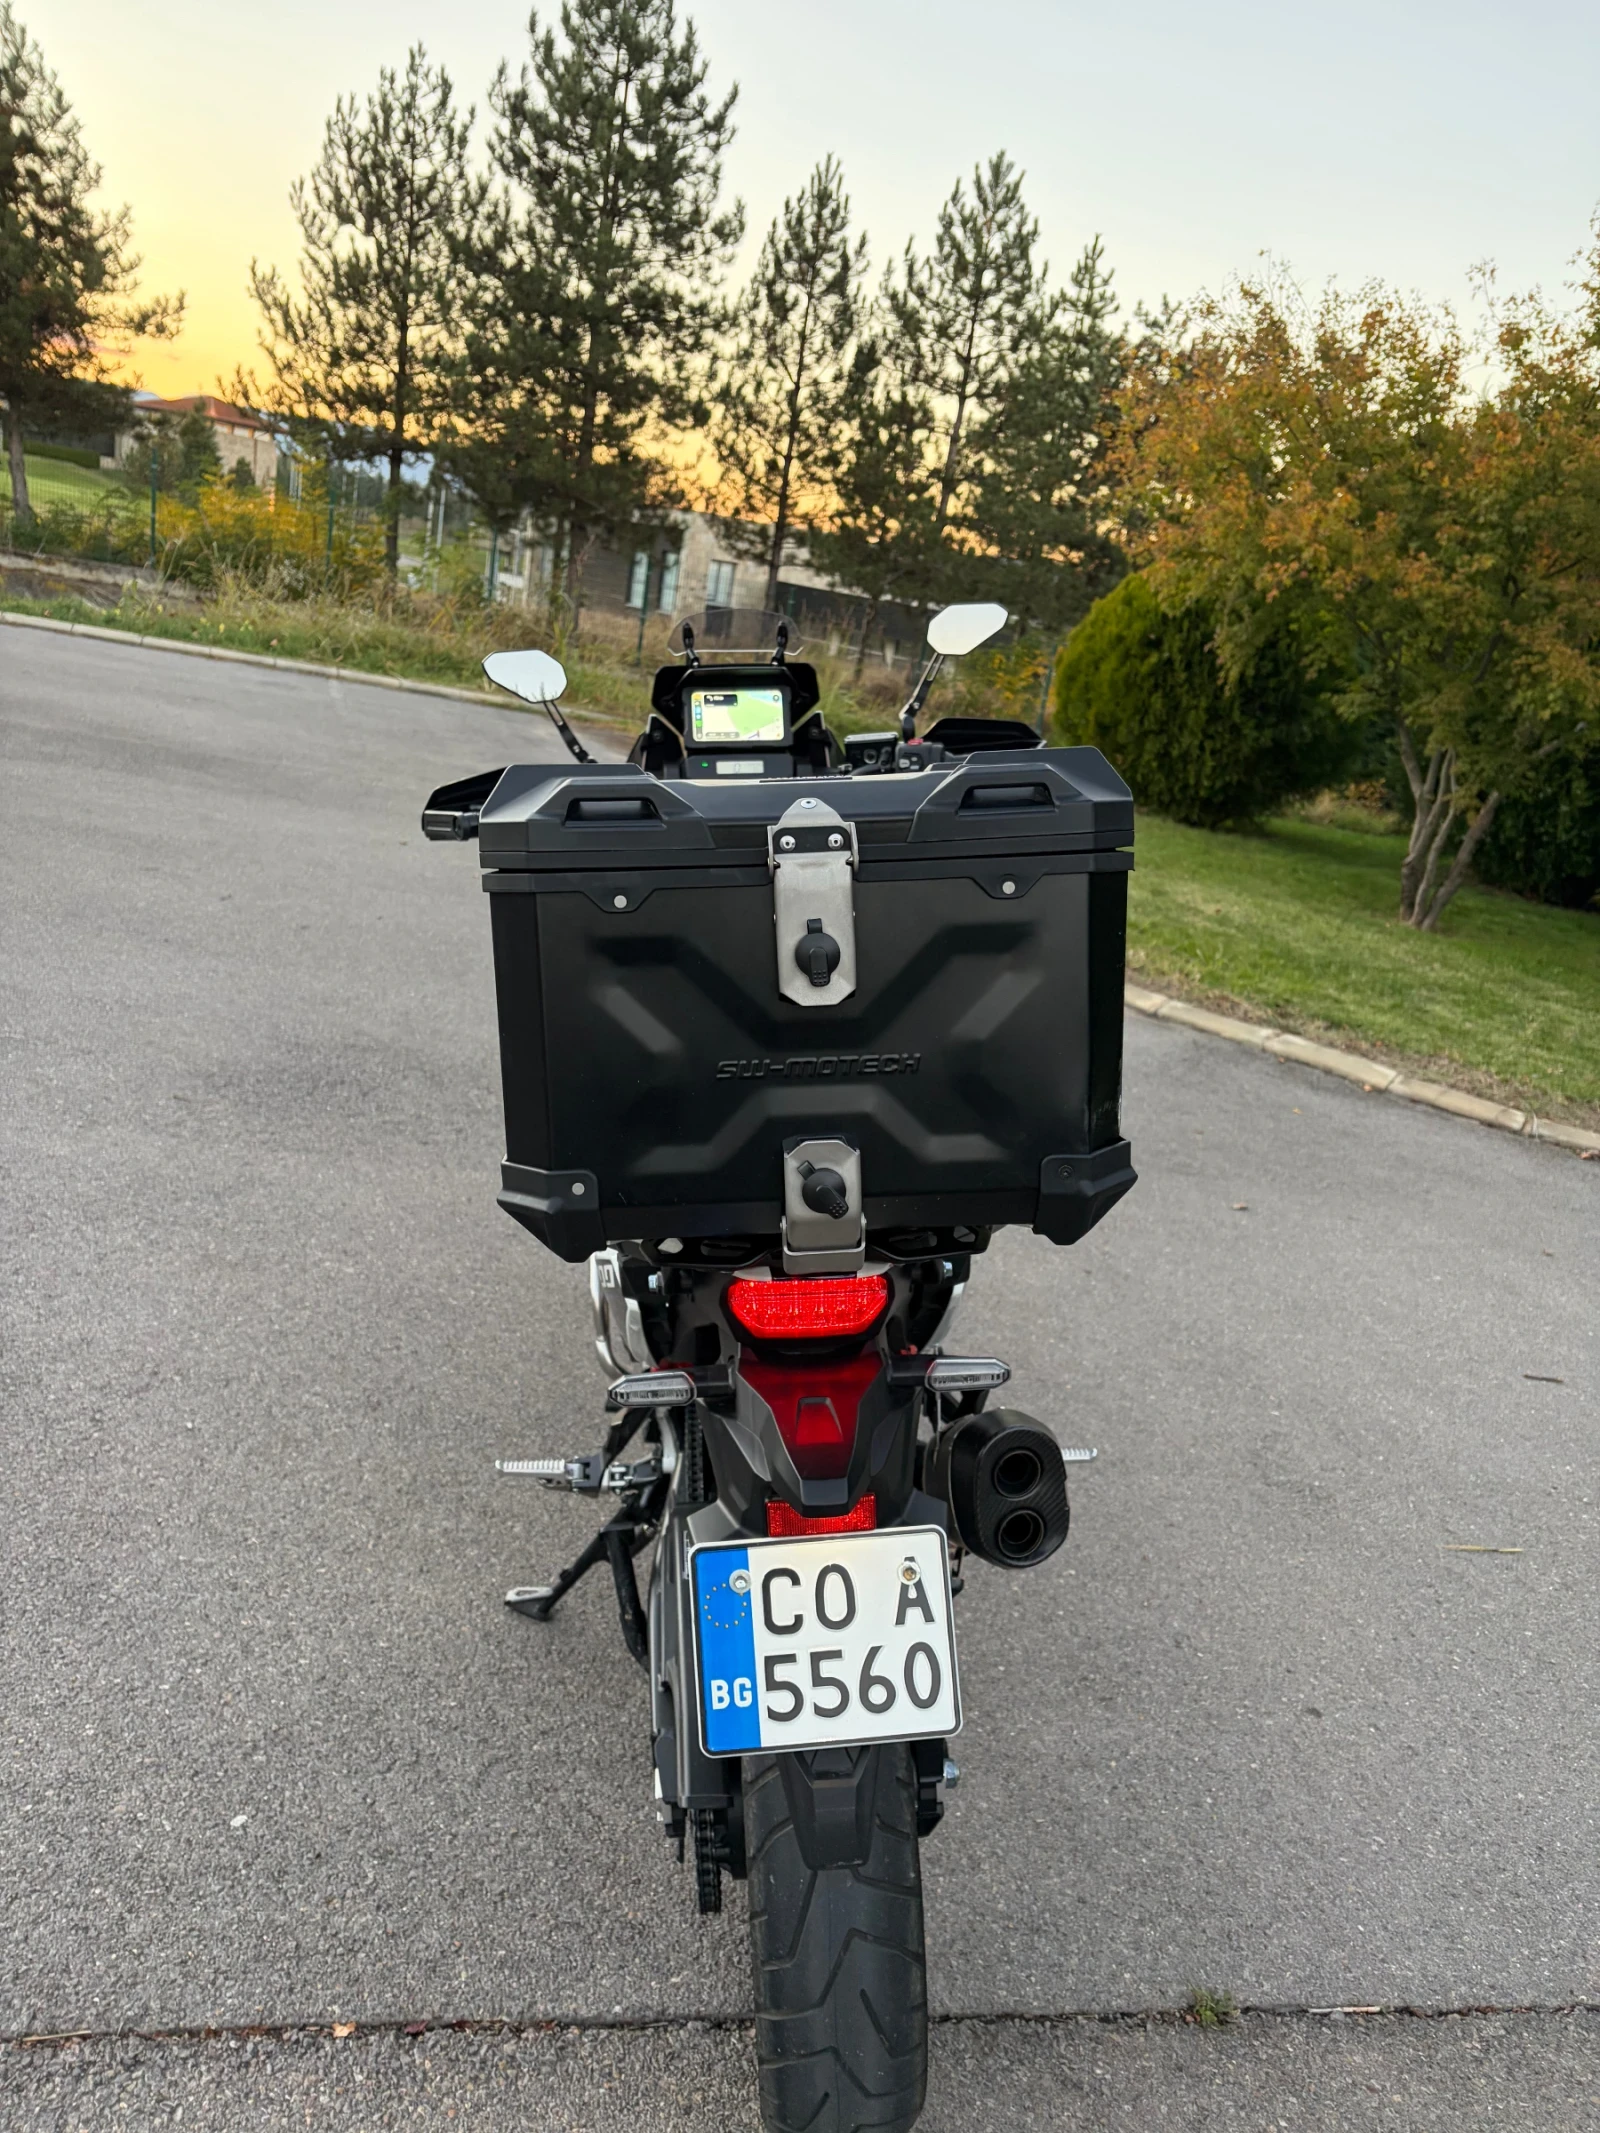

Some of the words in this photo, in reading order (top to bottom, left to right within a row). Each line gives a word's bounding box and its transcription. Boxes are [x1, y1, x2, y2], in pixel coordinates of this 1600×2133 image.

[716, 1052, 921, 1078] SW-MOTECH
[761, 1563, 857, 1635] CO
[894, 1556, 935, 1626] A
[710, 1677, 752, 1710] BG
[764, 1642, 941, 1722] 5560
